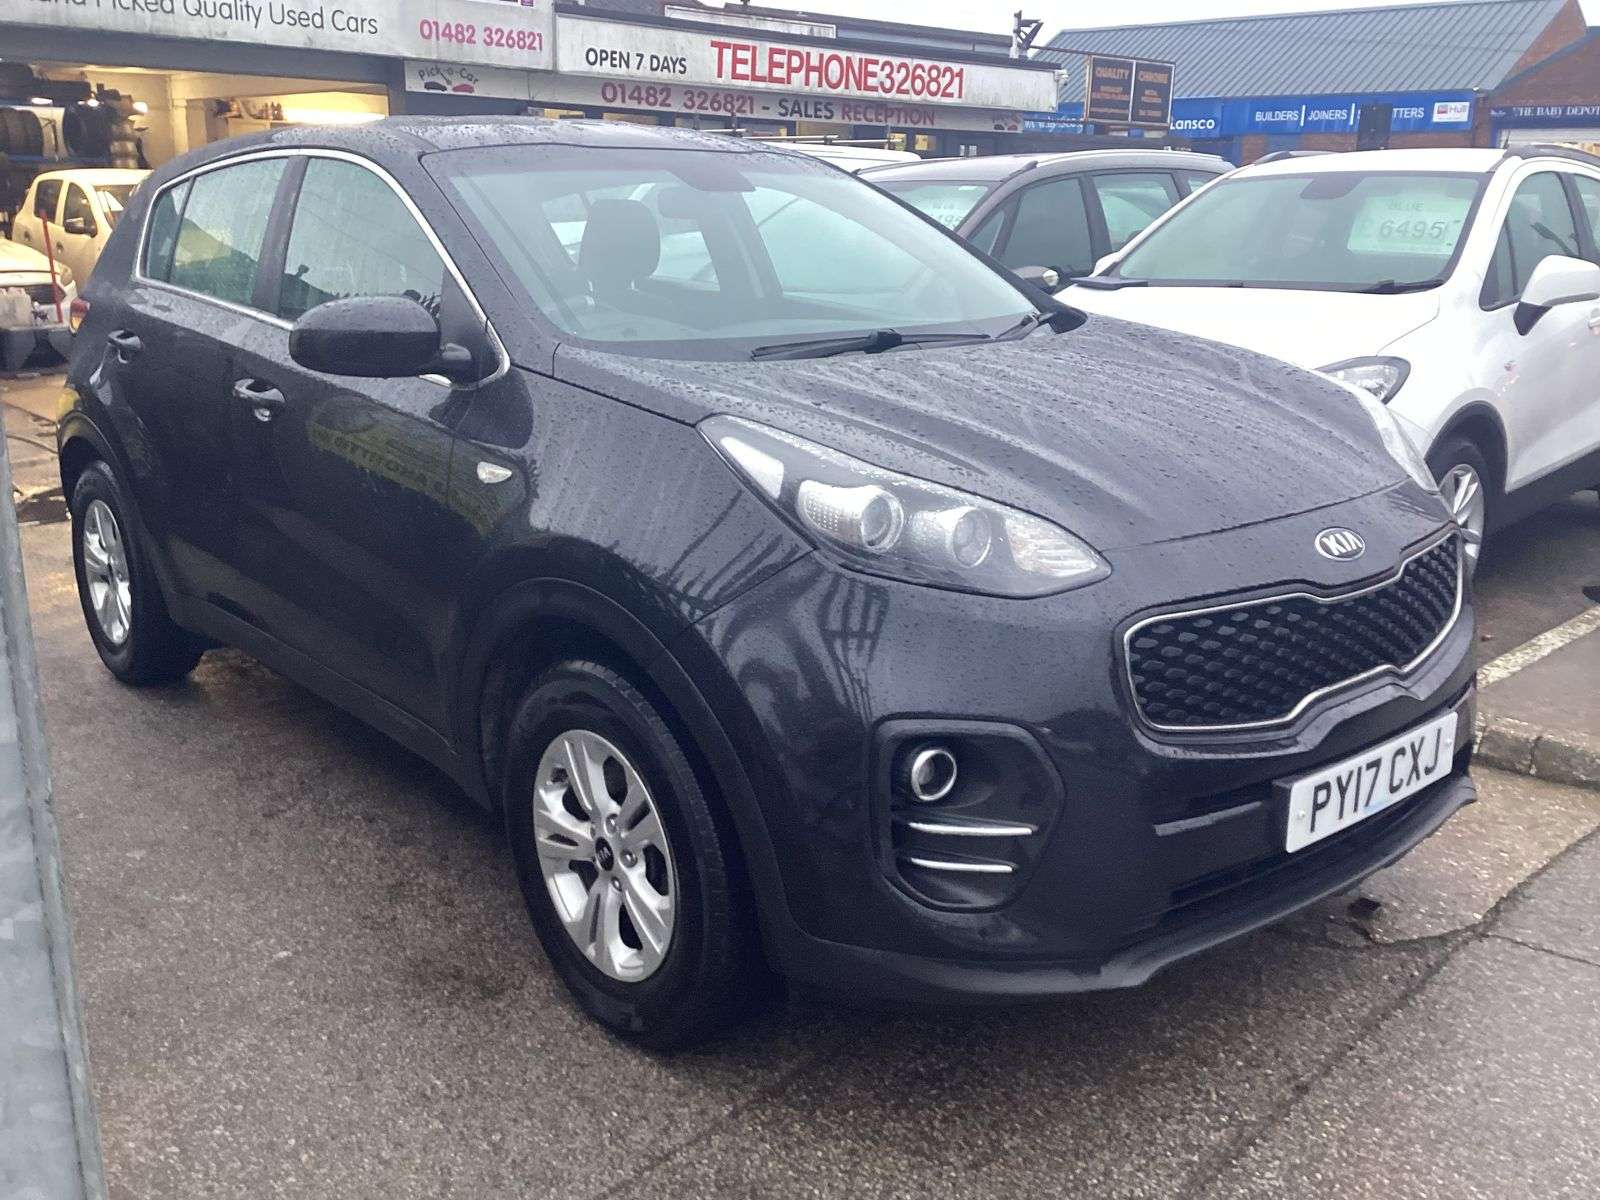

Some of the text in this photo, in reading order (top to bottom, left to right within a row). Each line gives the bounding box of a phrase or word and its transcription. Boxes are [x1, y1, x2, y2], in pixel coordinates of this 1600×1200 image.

[184, 0, 262, 28] Quality
[269, 2, 324, 29] Used
[331, 9, 378, 35] Cars
[419, 19, 544, 51] 01482 326821
[585, 47, 687, 75] OPEN 7 DAYS
[601, 81, 672, 108] 01482
[683, 89, 754, 115] 326821
[778, 101, 834, 120] SALES
[841, 102, 935, 126] RECEPTION
[1255, 110, 1299, 121] BUILDERS
[1307, 109, 1348, 120] JOINERS
[1537, 106, 1562, 118] BABY
[1320, 531, 1363, 555] KIA
[1310, 726, 1443, 833] PY17 CXJ
